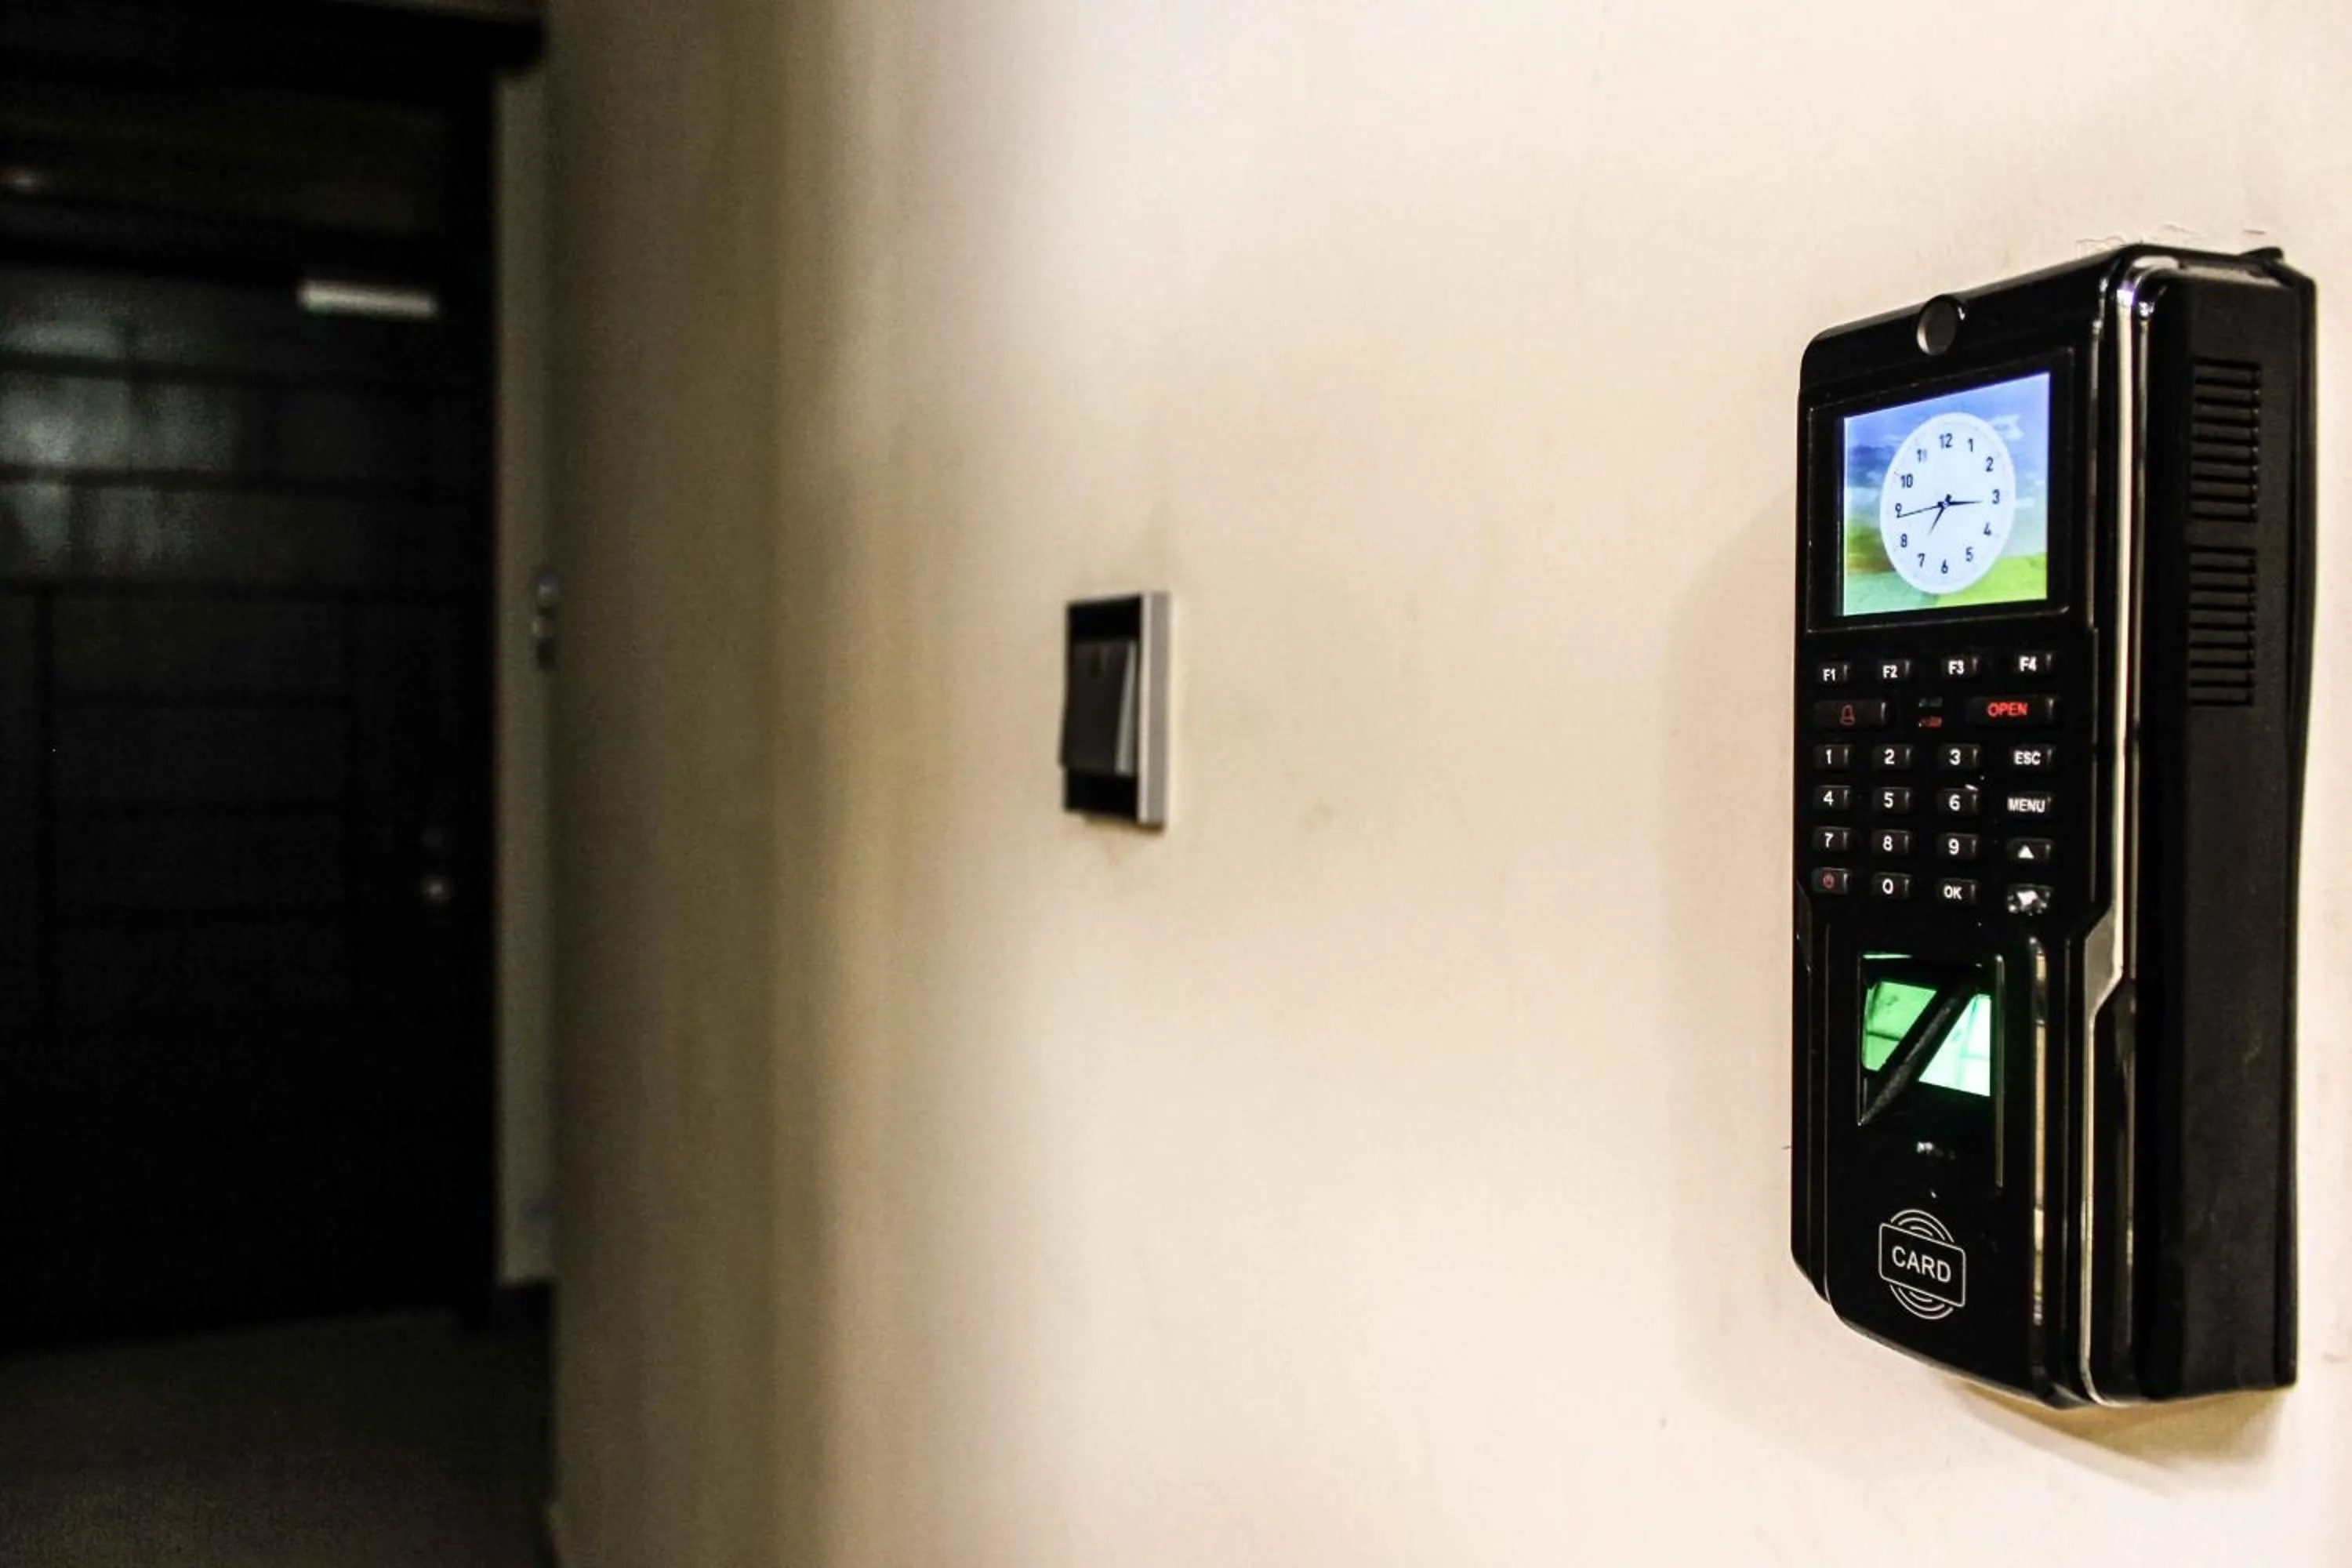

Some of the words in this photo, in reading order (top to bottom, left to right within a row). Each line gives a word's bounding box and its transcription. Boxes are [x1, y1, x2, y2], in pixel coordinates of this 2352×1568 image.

[1939, 433, 1953, 448] 12
[1967, 437, 1973, 452] 1
[1916, 448, 1928, 463] 11
[1986, 456, 1994, 473] 2
[1900, 473, 1914, 488] 10
[1991, 488, 2001, 505] 3
[1895, 503, 1903, 518] 9
[1983, 522, 1991, 536] 4
[1900, 533, 1907, 548] 8
[1917, 553, 1926, 568] 7
[1965, 546, 1973, 562] 5
[1940, 560, 1949, 575] 6
[1882, 664, 1898, 679] F2
[1948, 659, 1965, 675] F3
[2019, 655, 2037, 672] F4
[1823, 668, 1836, 681] F1
[1987, 702, 2027, 717] OPEN
[1825, 749, 1832, 764] 1
[1884, 748, 1895, 765] 2
[1950, 748, 1961, 766] 3
[2013, 750, 2042, 765] ESC
[1823, 790, 1834, 806] 4
[1884, 791, 1894, 808] 5
[1948, 793, 1961, 811] 6
[2008, 797, 2045, 813] MENU
[1824, 832, 1834, 848] 7
[1882, 835, 1893, 851] 8
[1948, 838, 1960, 855] 9
[1882, 878, 1894, 895] 0
[1944, 884, 1962, 900] OK
[1891, 1245, 1952, 1283] CARD
